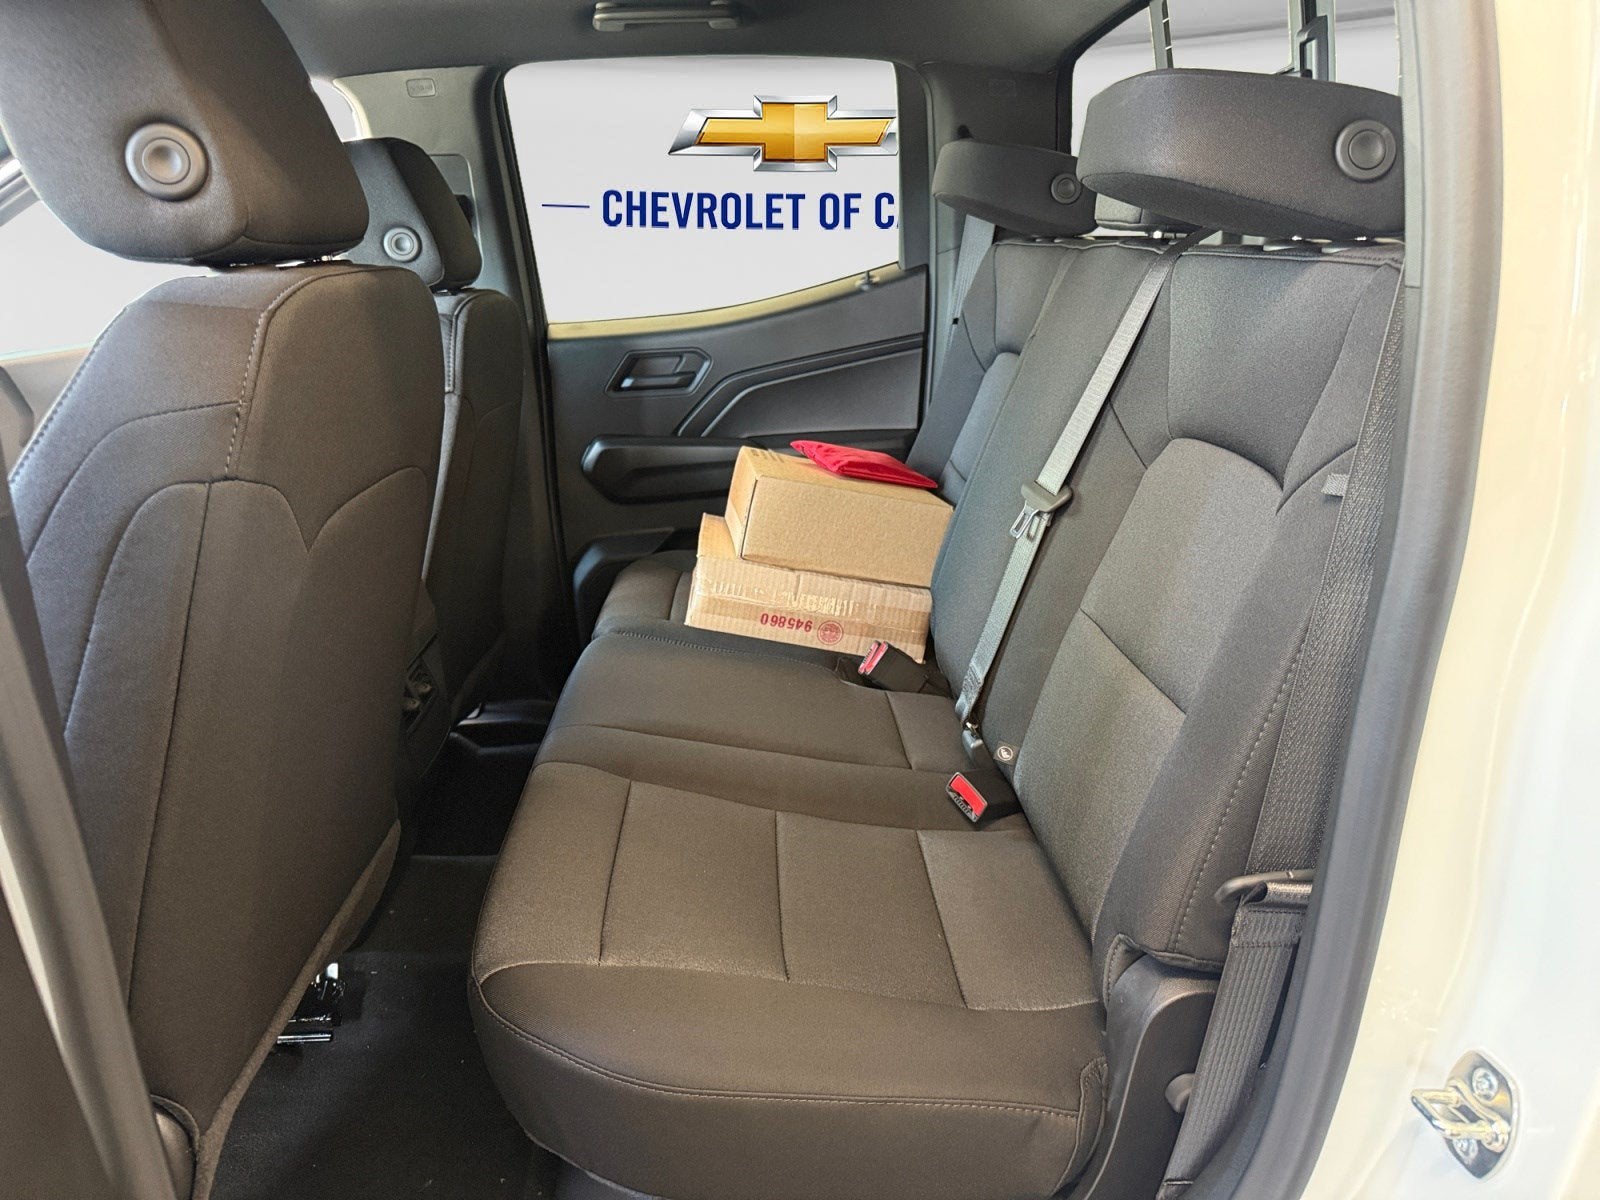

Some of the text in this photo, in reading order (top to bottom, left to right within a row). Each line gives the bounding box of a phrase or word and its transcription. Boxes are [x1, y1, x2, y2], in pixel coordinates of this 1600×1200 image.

[602, 189, 899, 230] CHEVROLET OF C
[760, 612, 814, 633] 945860
